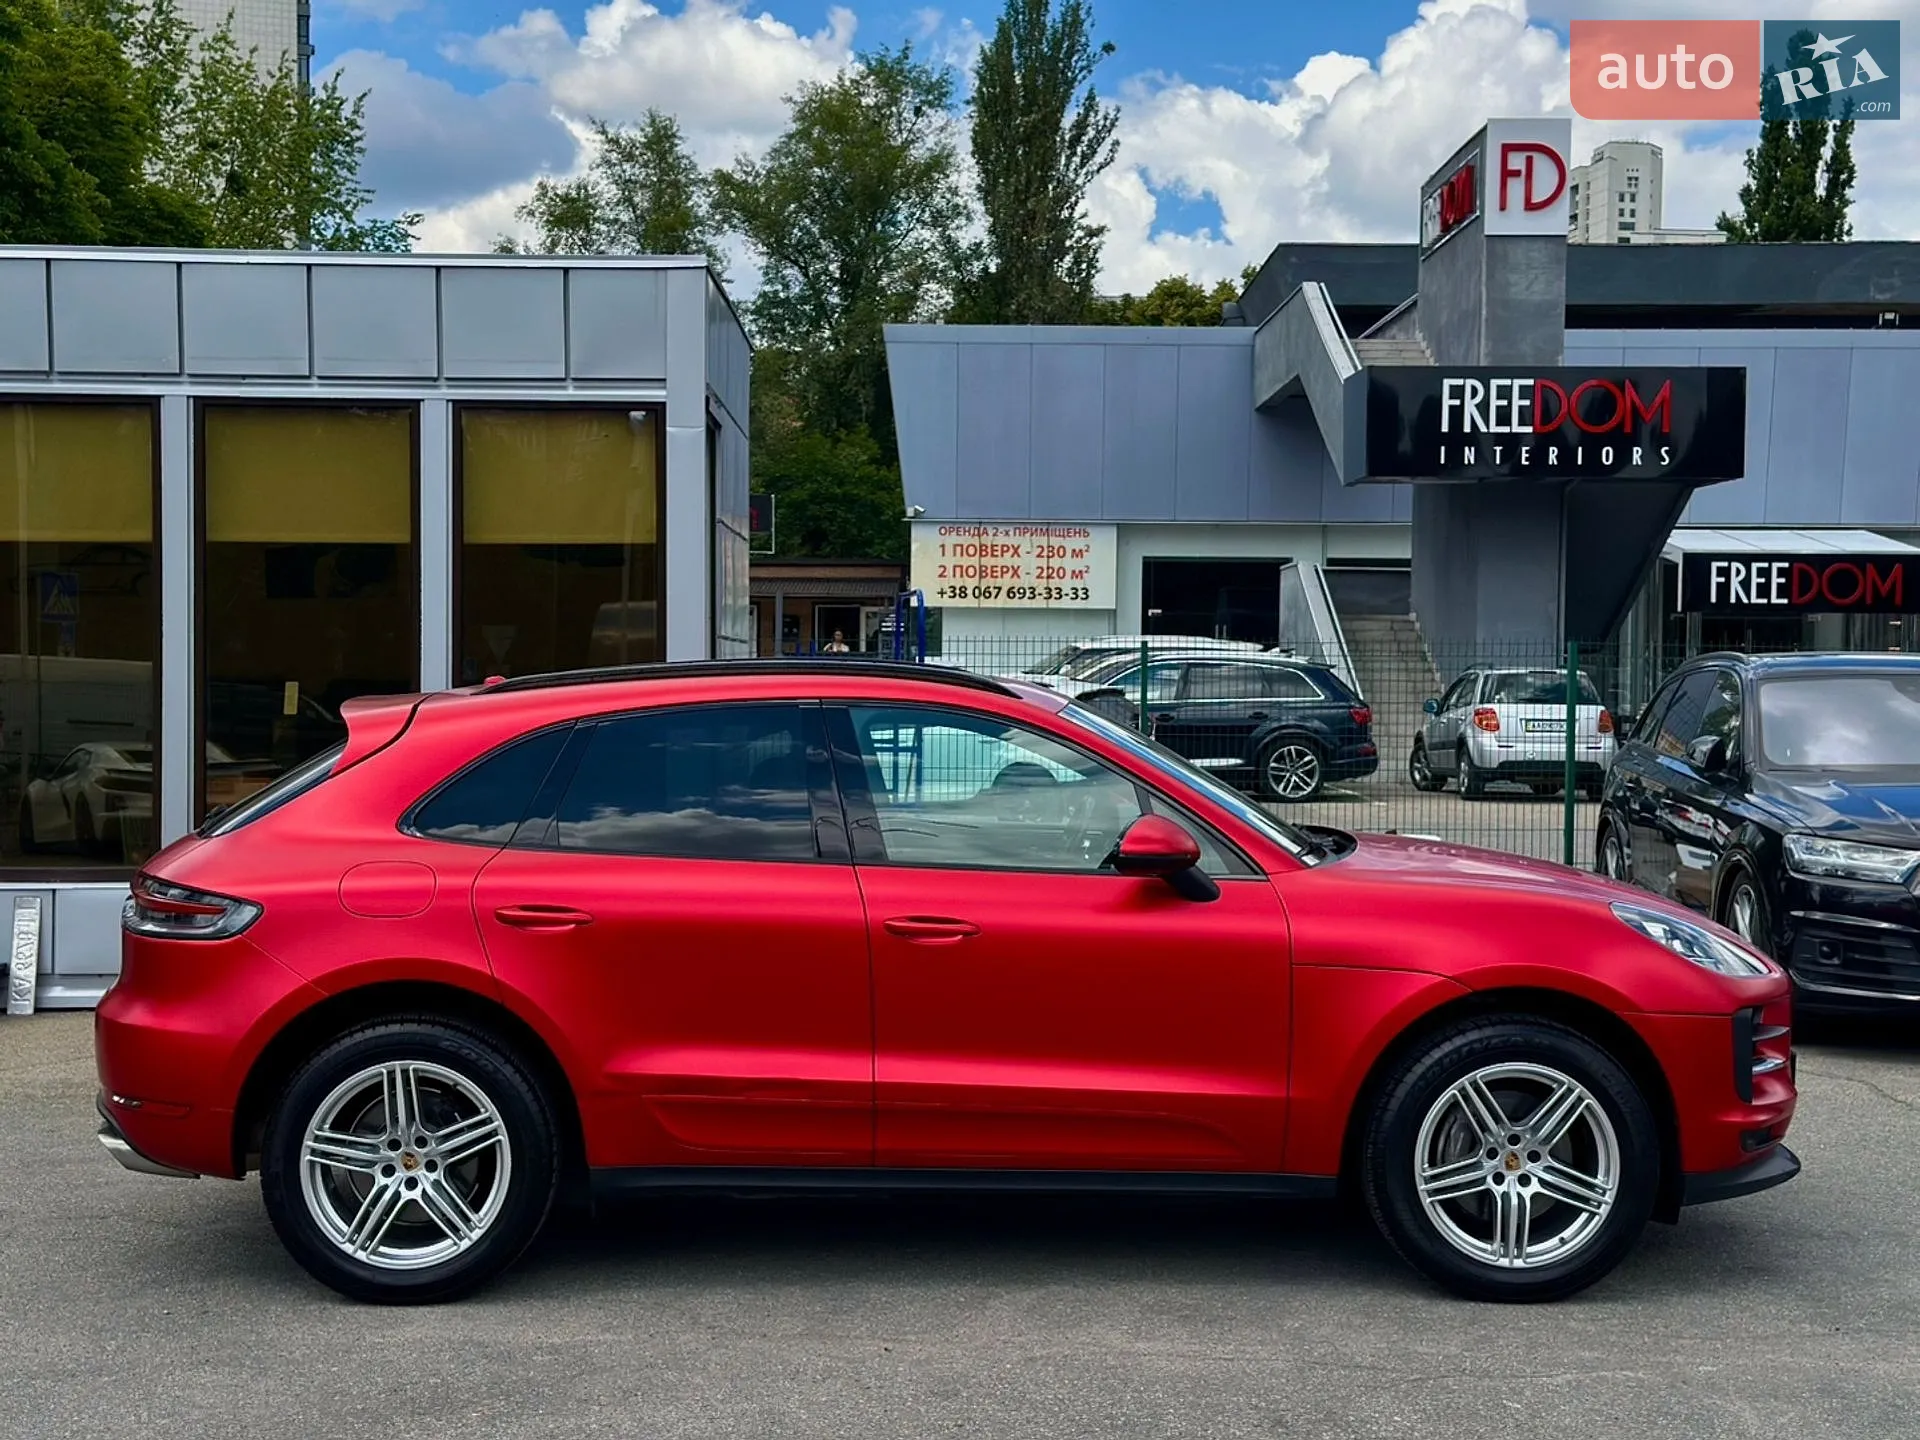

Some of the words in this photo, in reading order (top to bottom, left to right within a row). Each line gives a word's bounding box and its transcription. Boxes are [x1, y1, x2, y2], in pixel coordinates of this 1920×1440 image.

[1440, 378, 1672, 434] FREEDOM
[1440, 445, 1671, 466] INTERIORS
[938, 526, 989, 538] ОРЕНДА
[1013, 527, 1090, 539] ПРИМІЩЕНЬ
[938, 544, 946, 557] 1
[952, 544, 1021, 558] ПОВЕРХ
[1035, 545, 1067, 559] 230
[937, 565, 948, 579] 2
[952, 565, 1021, 579] ПОВЕРХ
[1035, 566, 1067, 580] 220
[1710, 561, 1903, 606] FREEDOM
[936, 586, 968, 600] +38
[971, 586, 1003, 600] 067
[1006, 586, 1090, 600] 693-33-33
